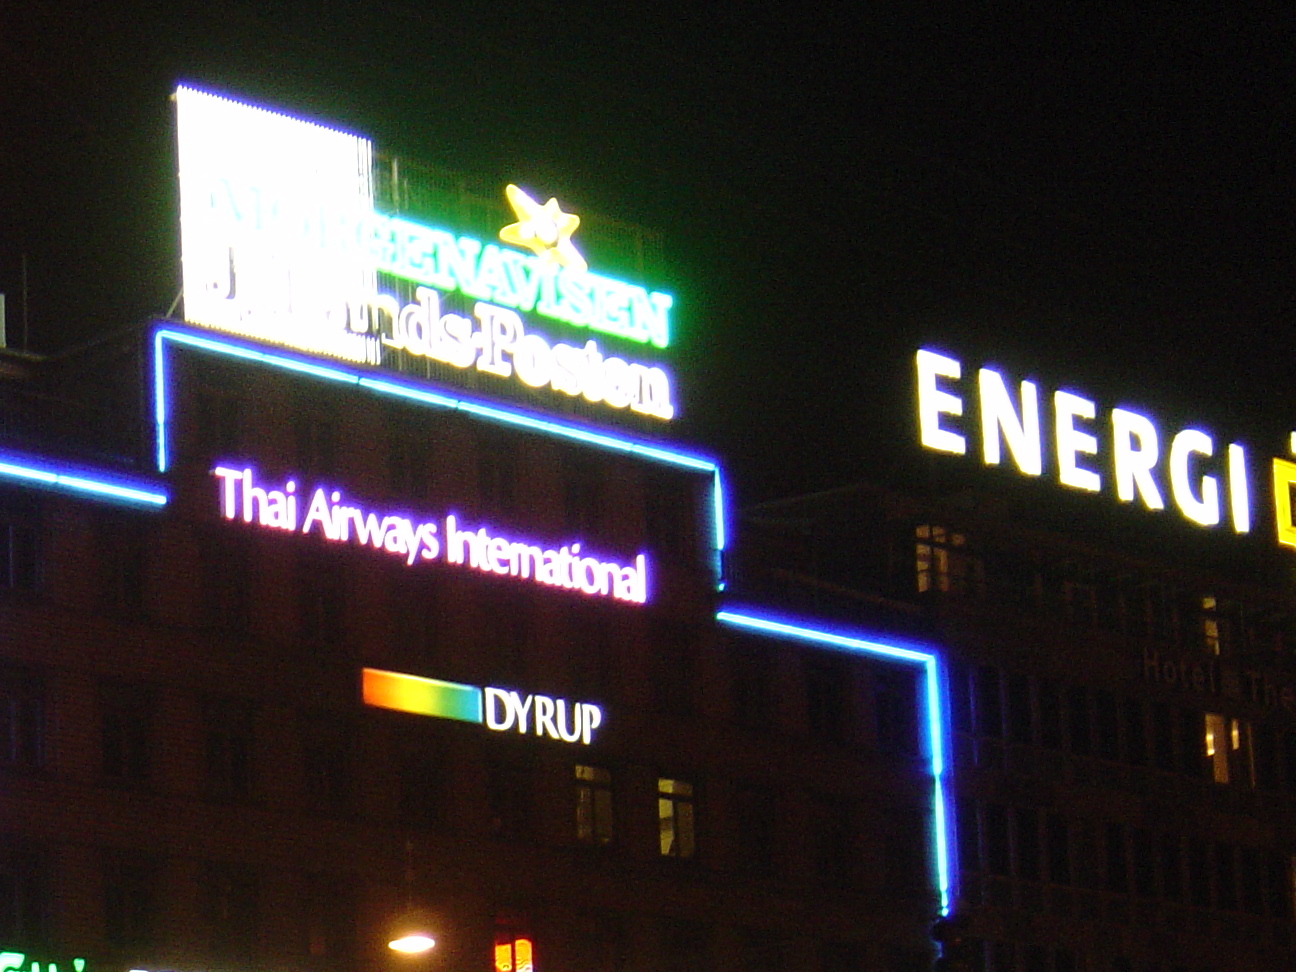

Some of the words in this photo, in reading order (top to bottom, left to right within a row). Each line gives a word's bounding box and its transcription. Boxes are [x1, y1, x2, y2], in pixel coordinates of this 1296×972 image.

[916, 348, 1250, 534] ENERGI
[215, 466, 297, 532] Thai
[304, 488, 439, 564] Airways
[447, 515, 647, 603] International
[485, 687, 602, 745] DYRUP
